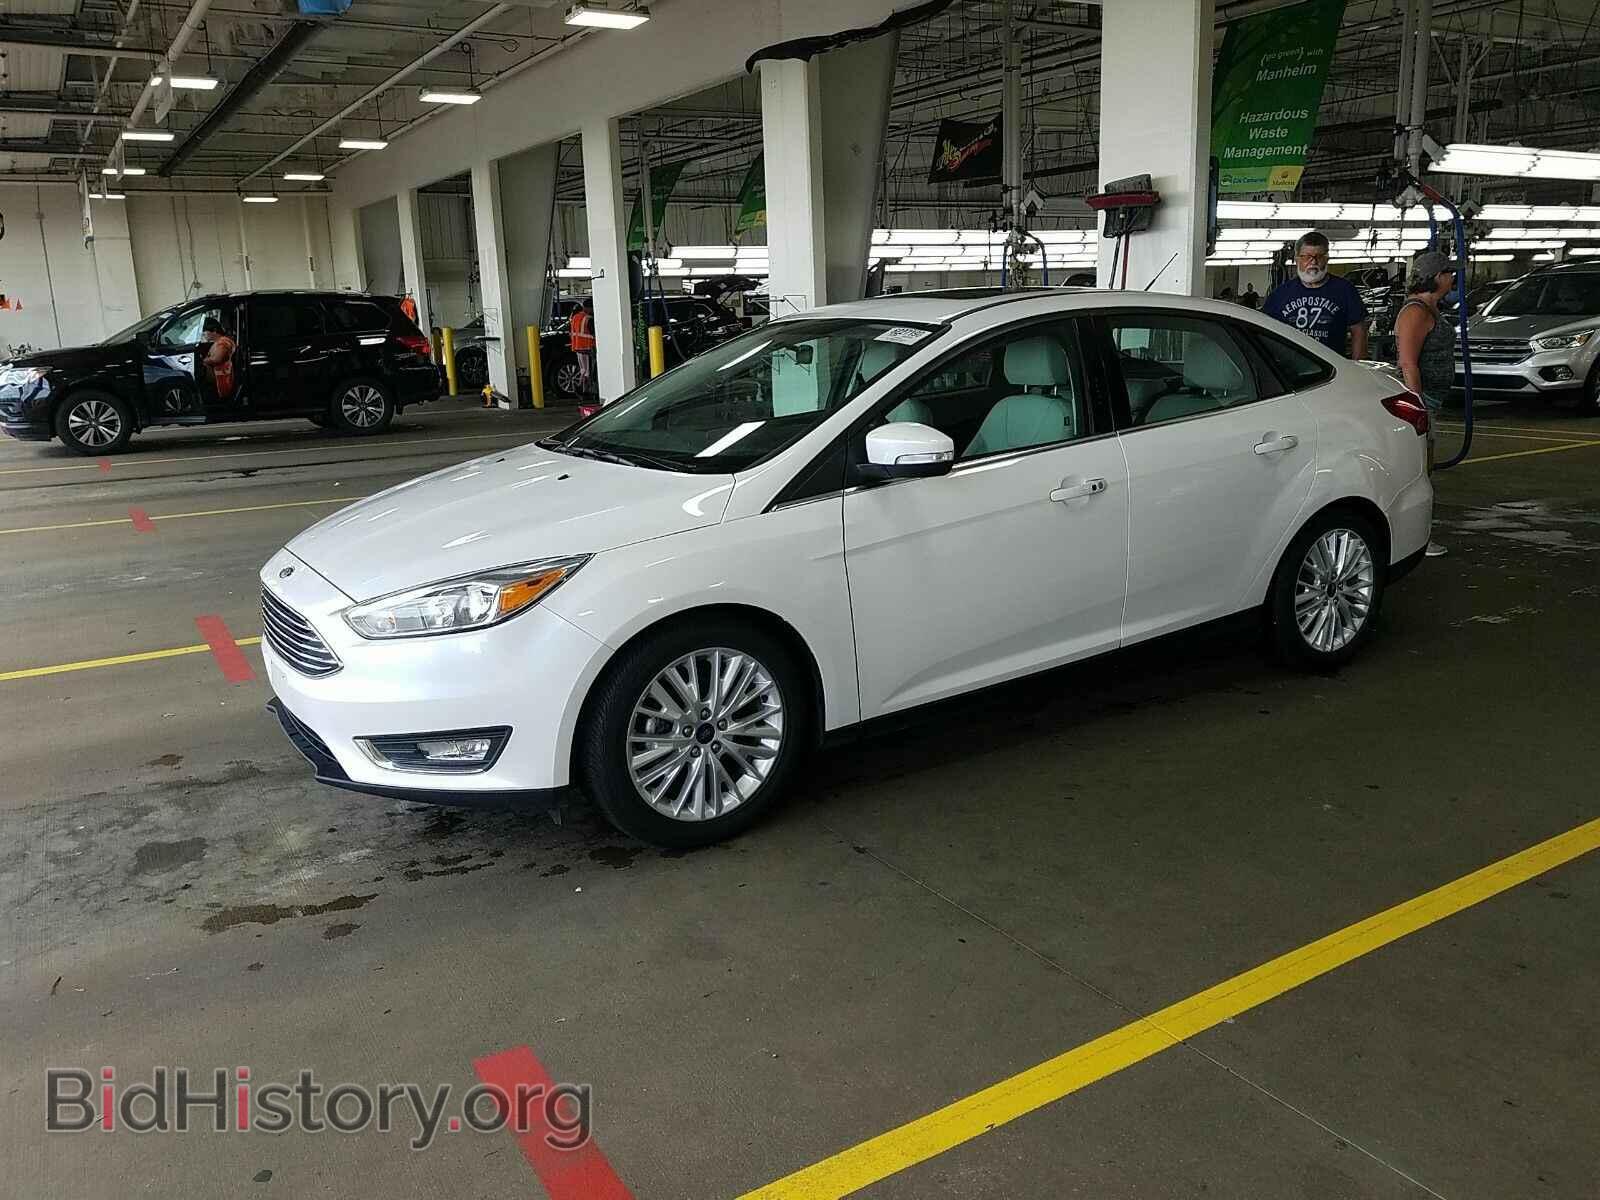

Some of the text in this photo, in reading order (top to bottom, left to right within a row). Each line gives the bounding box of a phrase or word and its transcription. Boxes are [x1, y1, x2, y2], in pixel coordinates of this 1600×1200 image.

[1256, 62, 1318, 82] Manheim
[1240, 107, 1310, 124] Hazardous
[1249, 126, 1289, 140] Waste
[1223, 143, 1309, 160] Management
[1281, 296, 1340, 318] AEROPOSTALE
[1296, 307, 1322, 329] 87
